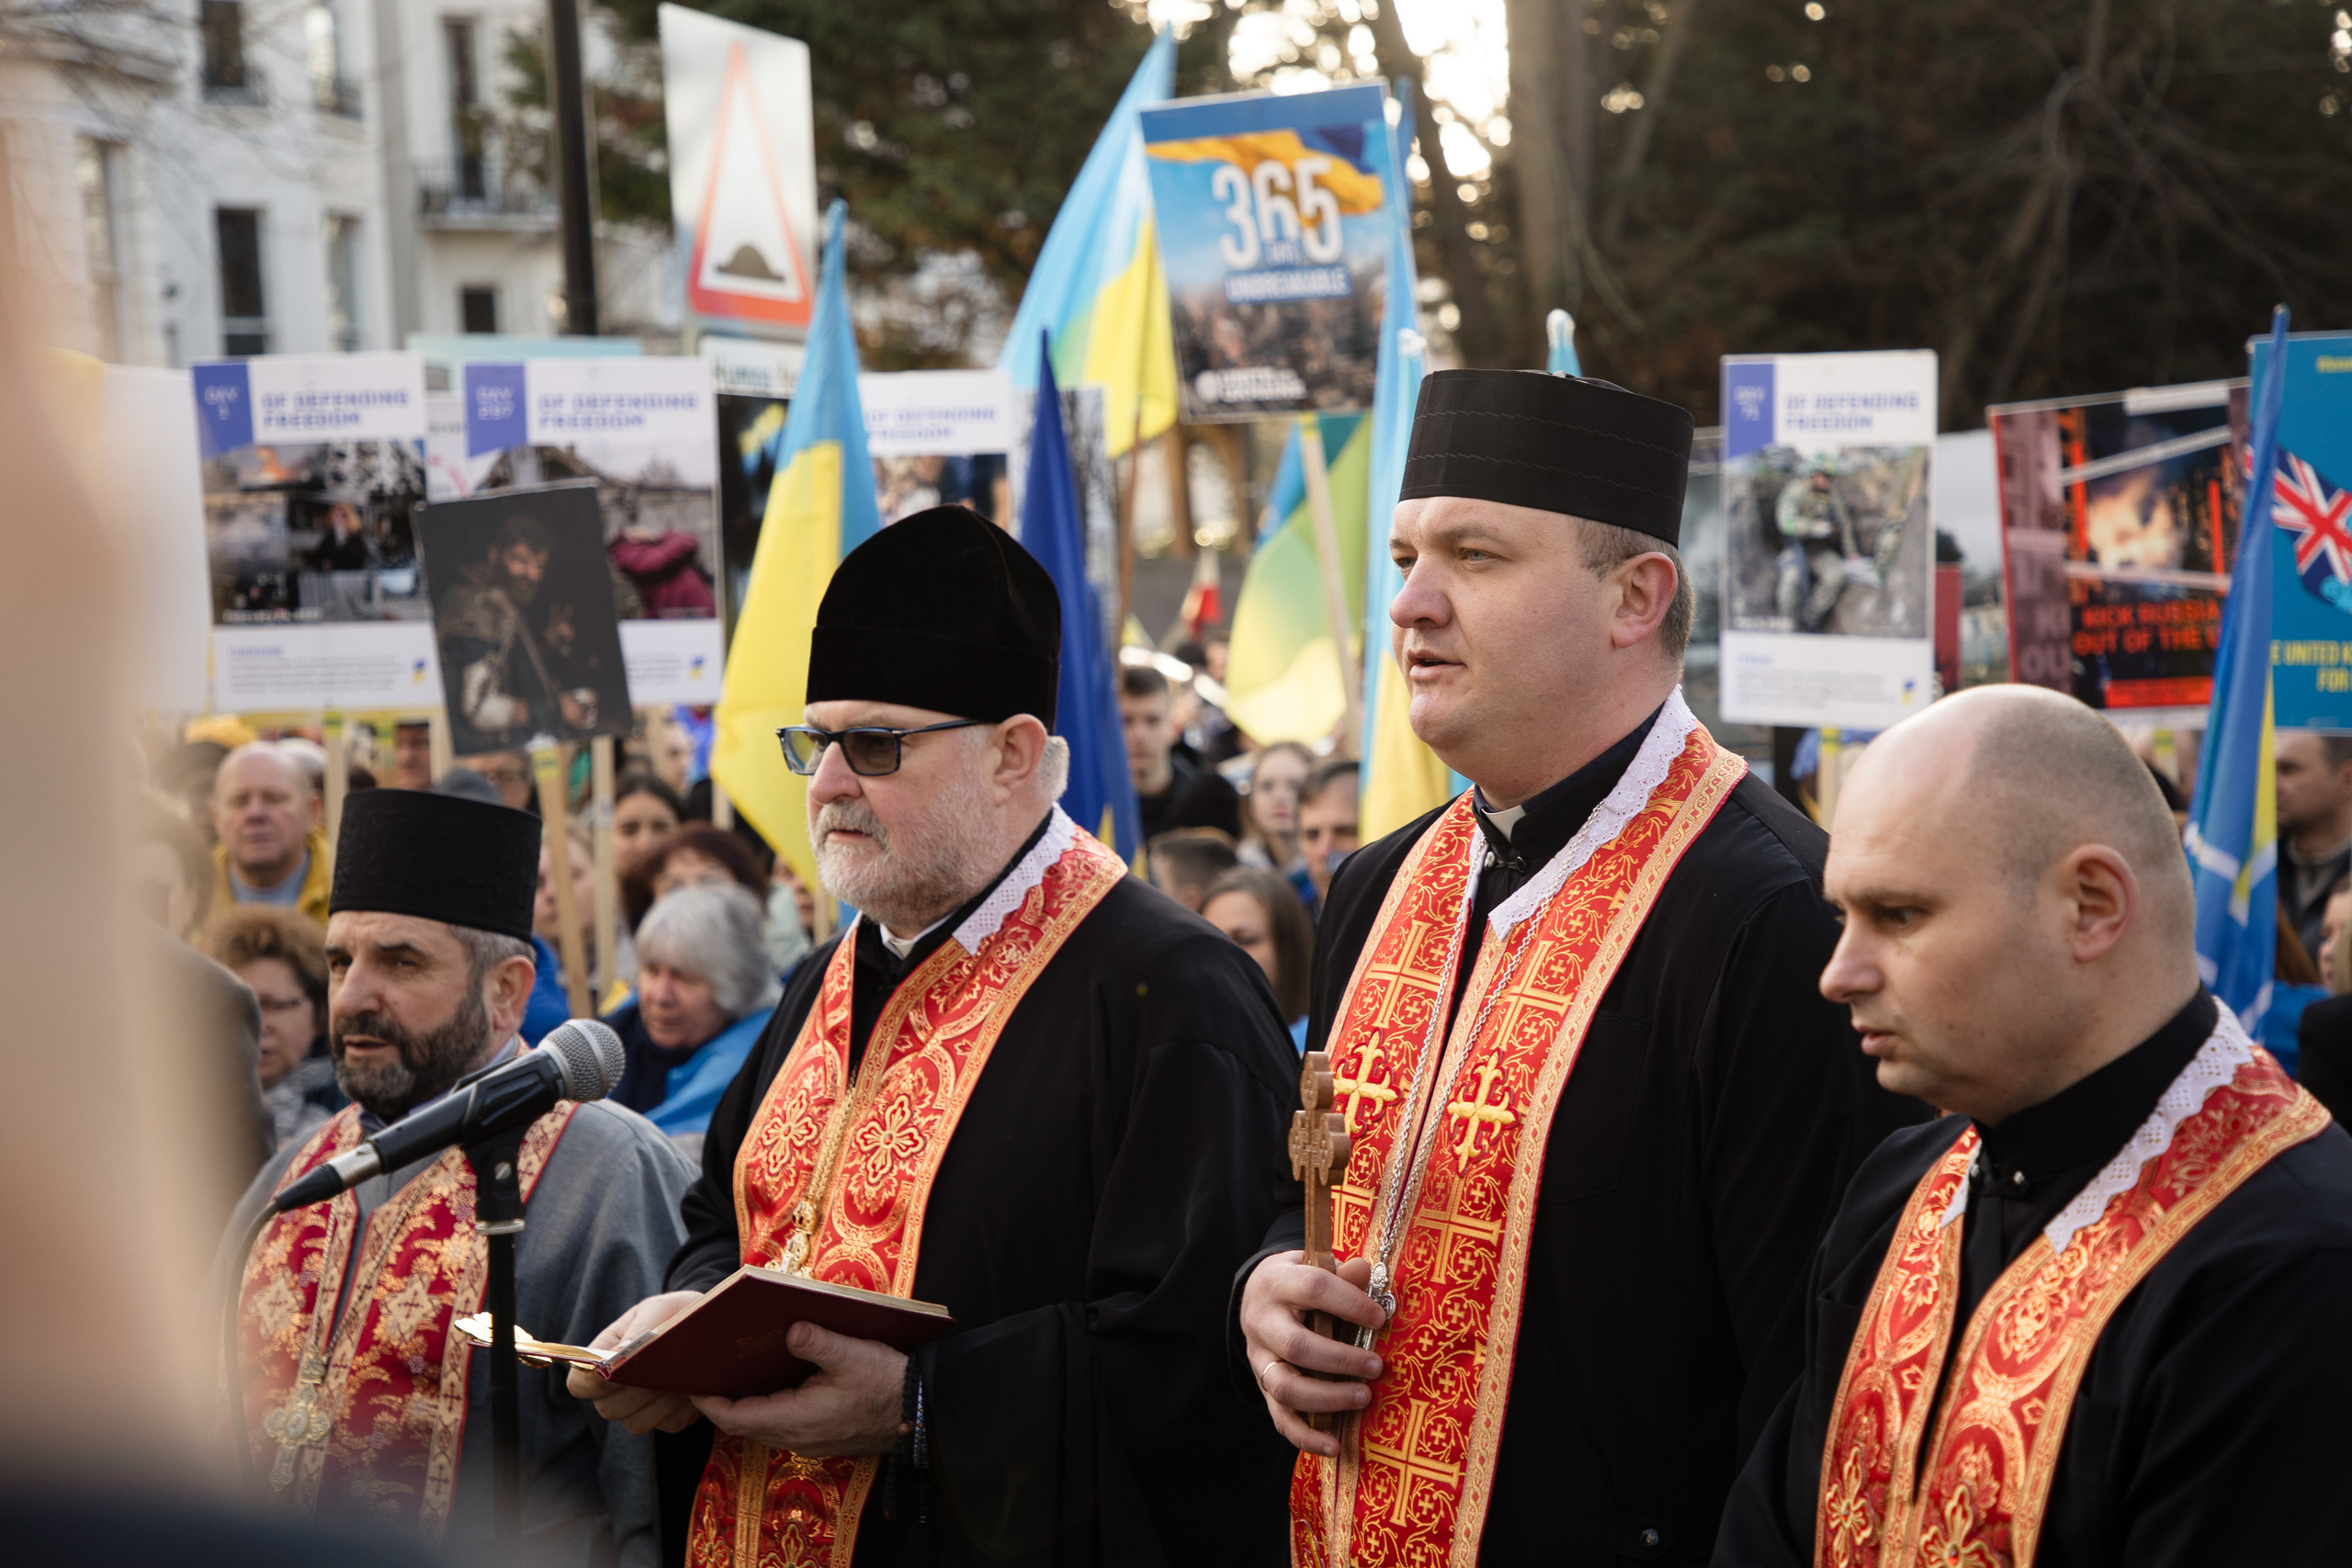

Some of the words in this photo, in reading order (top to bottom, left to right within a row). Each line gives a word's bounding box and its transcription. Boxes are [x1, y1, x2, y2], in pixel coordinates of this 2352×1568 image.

[1212, 156, 1342, 270] 365
[1226, 267, 1346, 301] UNBREAKABLE
[206, 387, 238, 403] DAY
[263, 393, 288, 408] OF
[294, 389, 408, 407] DEFENDING
[478, 387, 512, 401] DAY
[538, 395, 564, 409] OF
[573, 393, 696, 409] DEFENDING
[1735, 387, 1765, 403] DAY
[1786, 393, 1807, 410] OF
[1815, 392, 1918, 409] DEFENDING
[263, 412, 361, 428] FREEDOM
[539, 413, 643, 428] FREEDOM
[897, 406, 995, 421] DEFENDING
[1786, 416, 1872, 431] FREEDOM
[2082, 604, 2134, 628] KICK
[2137, 600, 2220, 626] RUSSIA
[2073, 629, 2117, 656] OUT
[2122, 626, 2152, 653] OF
[2159, 625, 2203, 651] THE
[2284, 640, 2339, 666] UNITED
[2316, 667, 2348, 693] FOR
